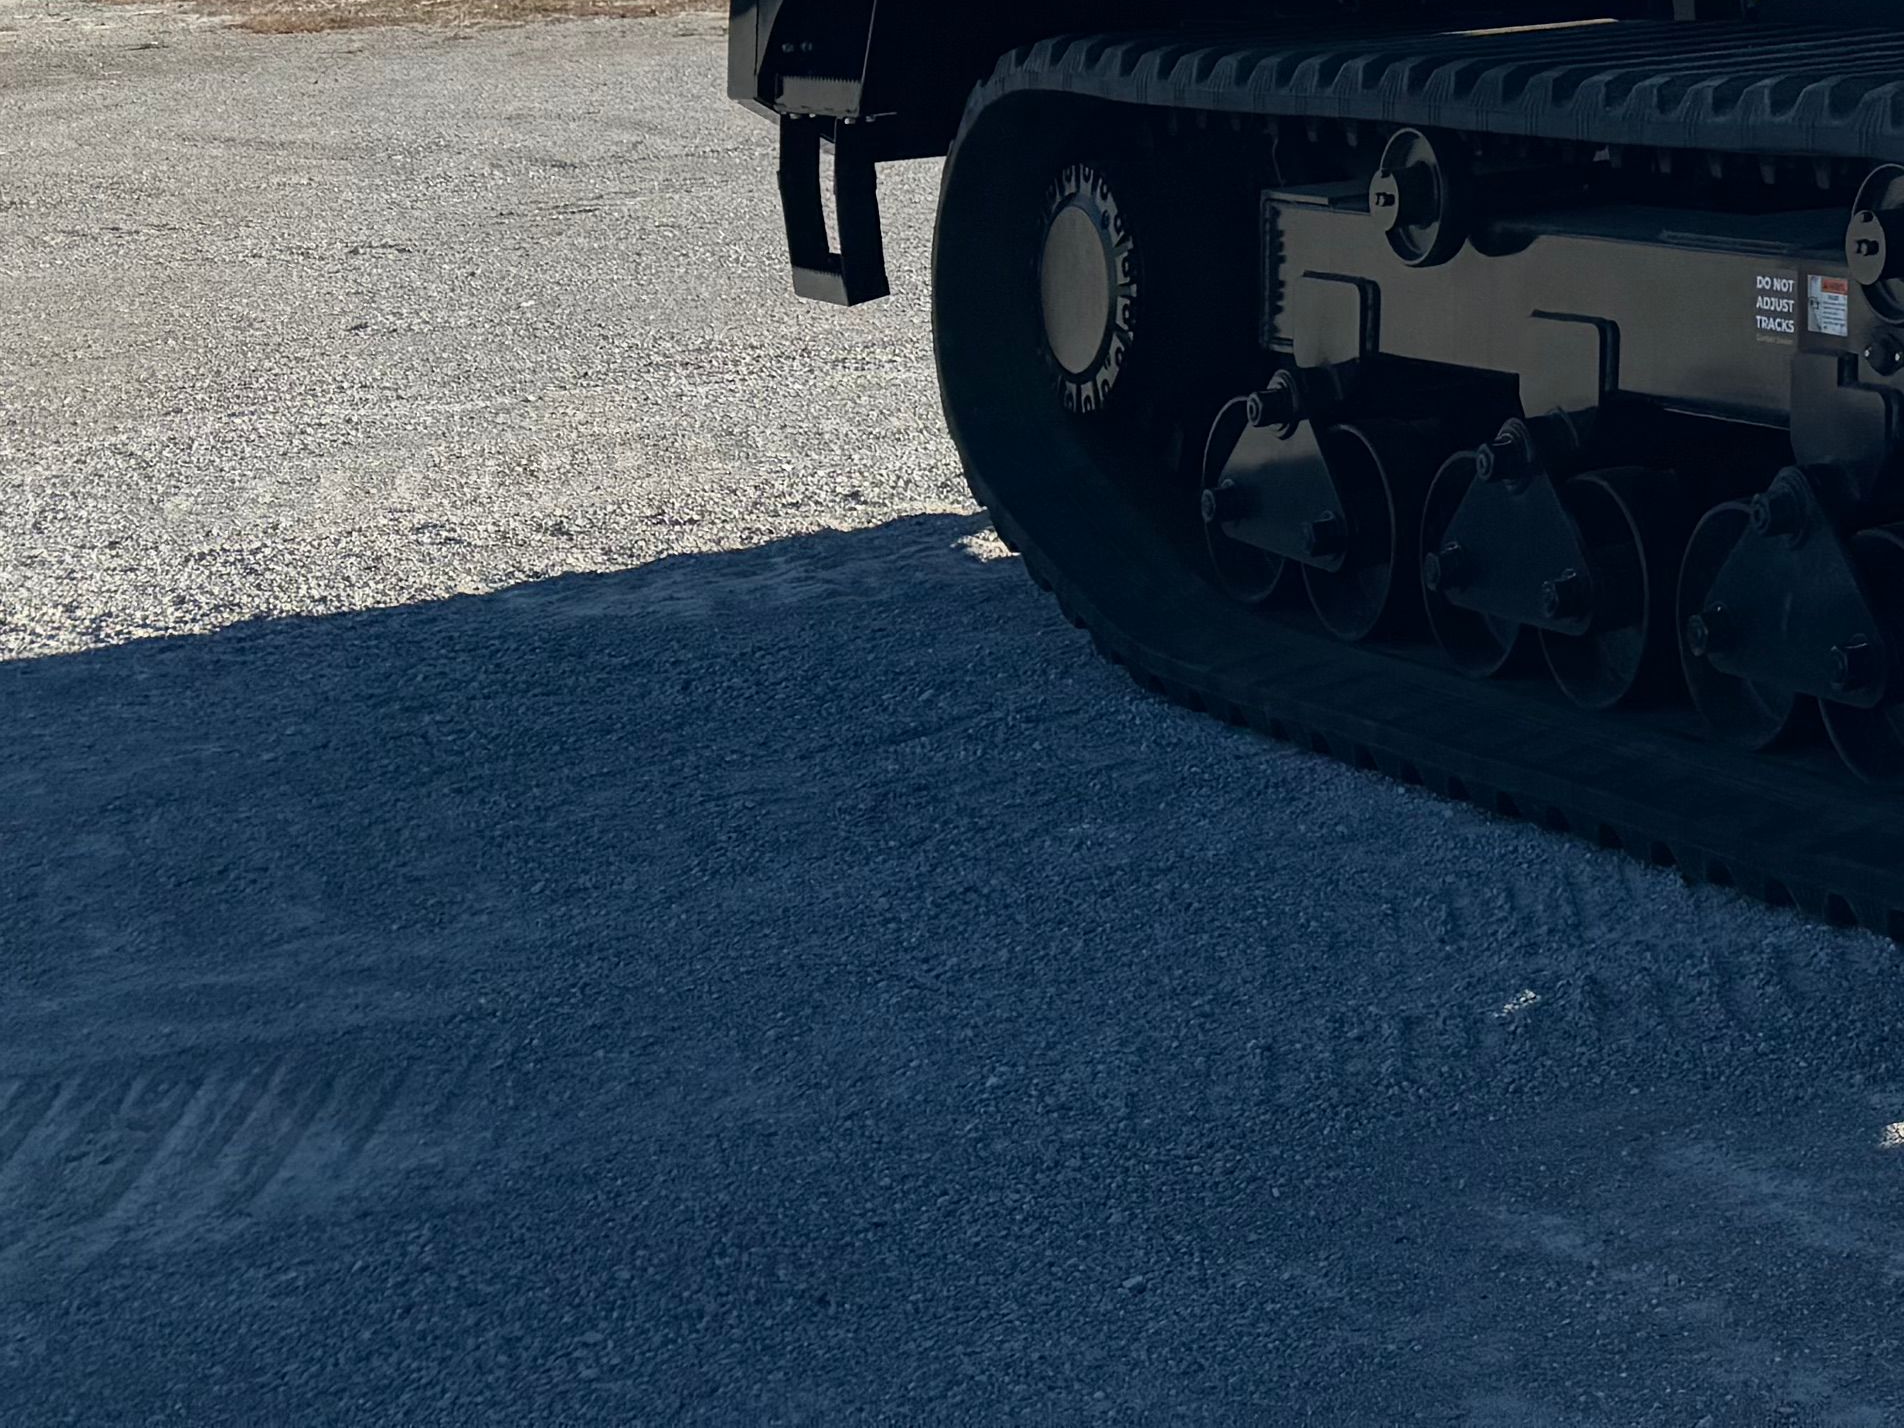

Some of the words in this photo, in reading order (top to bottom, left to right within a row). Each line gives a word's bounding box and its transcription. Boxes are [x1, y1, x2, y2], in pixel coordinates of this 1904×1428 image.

[1756, 276, 1771, 289] DO
[1773, 279, 1794, 292] NOT
[1756, 296, 1794, 312] ADJUST
[1756, 316, 1794, 332] TRACKS
